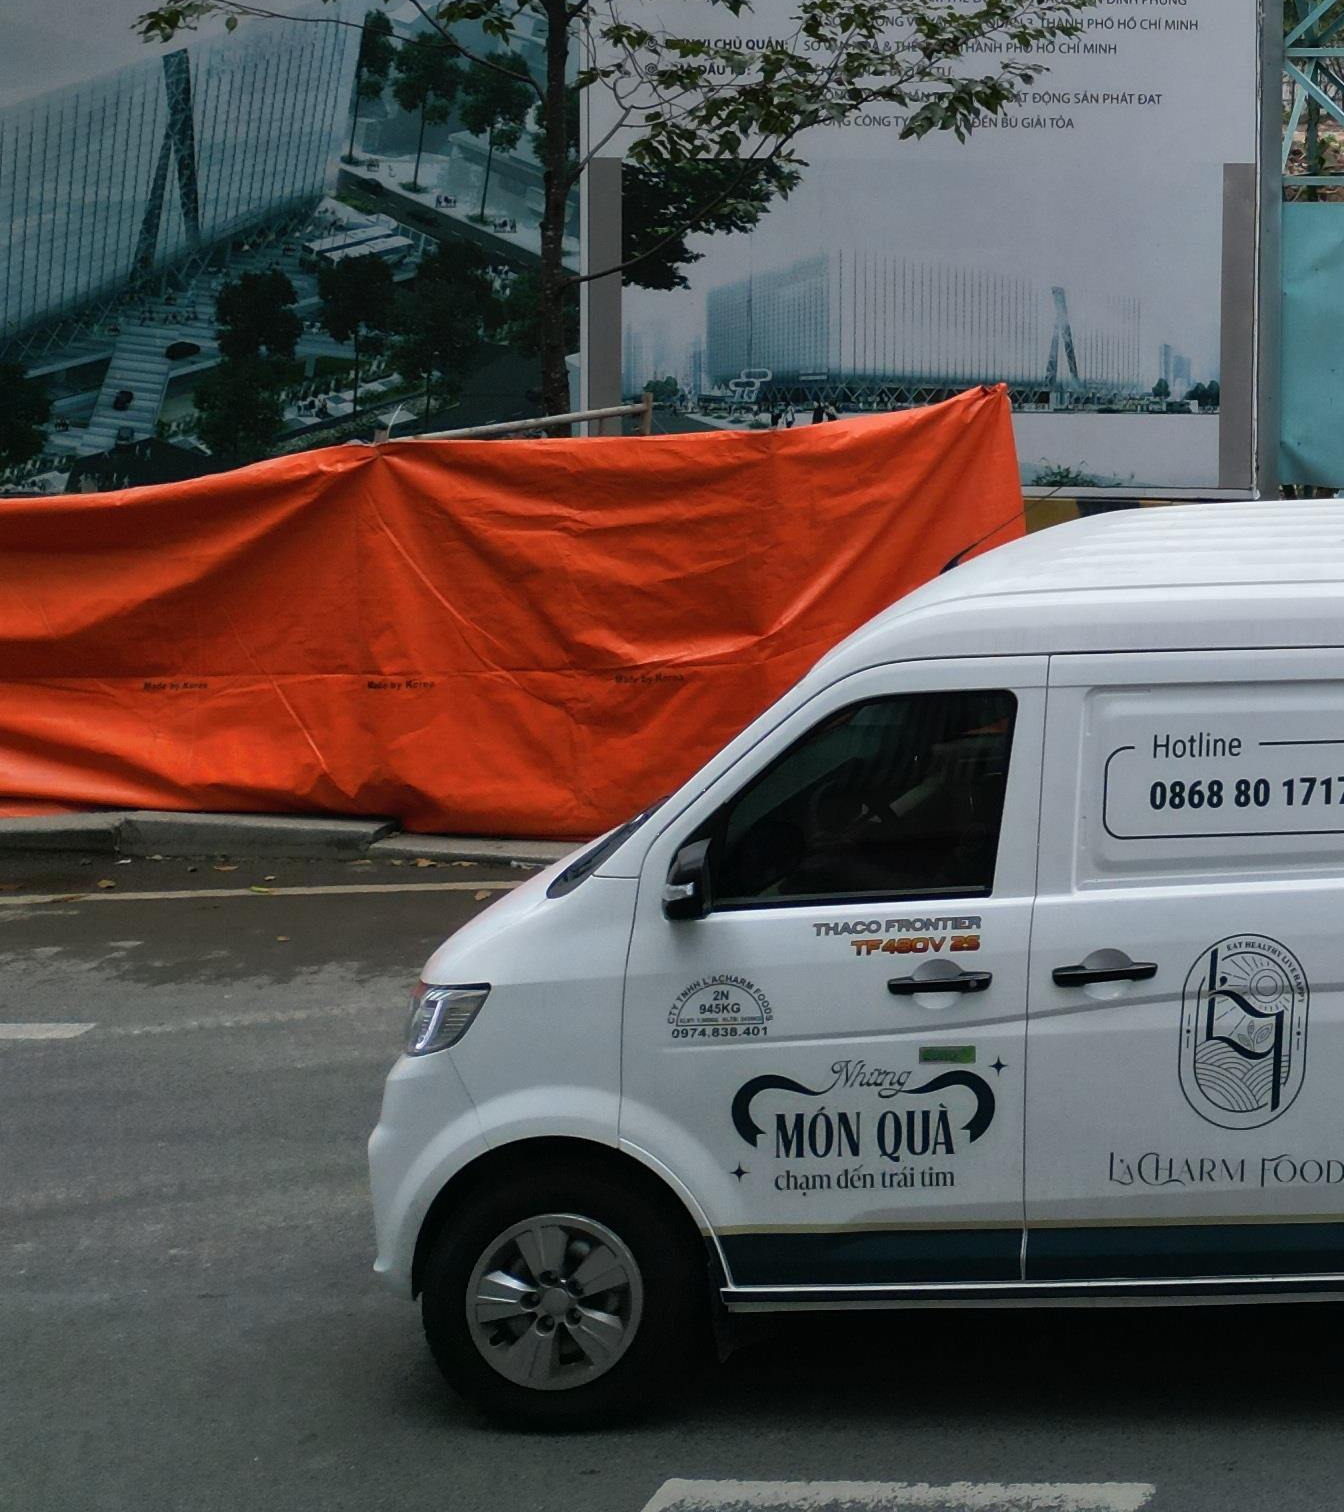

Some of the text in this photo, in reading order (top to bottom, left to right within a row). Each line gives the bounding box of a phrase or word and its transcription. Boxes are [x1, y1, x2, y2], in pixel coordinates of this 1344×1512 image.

[1088, 14, 1114, 29] PHỐ
[1118, 14, 1137, 29] HỒ
[1140, 15, 1161, 30] CHÍ
[1165, 19, 1199, 31] MINH
[714, 36, 742, 50] CHỦ
[883, 41, 892, 51] &
[1059, 40, 1080, 54] CHÍ
[1084, 43, 1117, 55] MINH
[1033, 90, 1071, 105] ĐỘNG
[1074, 90, 1100, 104] SẢN
[1103, 91, 1135, 105] PHÁT
[855, 114, 891, 127] CÔNG
[1153, 732, 1242, 758] Hotline
[1150, 781, 1224, 810] 0868
[1235, 780, 1270, 808] 80
[813, 916, 982, 937] THACO FRONTIER
[1226, 941, 1243, 951] EAT
[1245, 941, 1282, 958] HEALTHY
[1281, 953, 1298, 974] LIVE
[713, 990, 729, 1001] 2N
[667, 1003, 679, 1025] CTY
[753, 987, 774, 1022] FOODS
[699, 1003, 741, 1015] 945KG
[671, 1026, 768, 1039] 0974.838.401
[831, 1060, 912, 1098] Những
[775, 1102, 955, 1162] MÓN QUÀ
[774, 1169, 832, 1196] chạm
[881, 1166, 915, 1188] trái
[921, 1167, 955, 1187] tim
